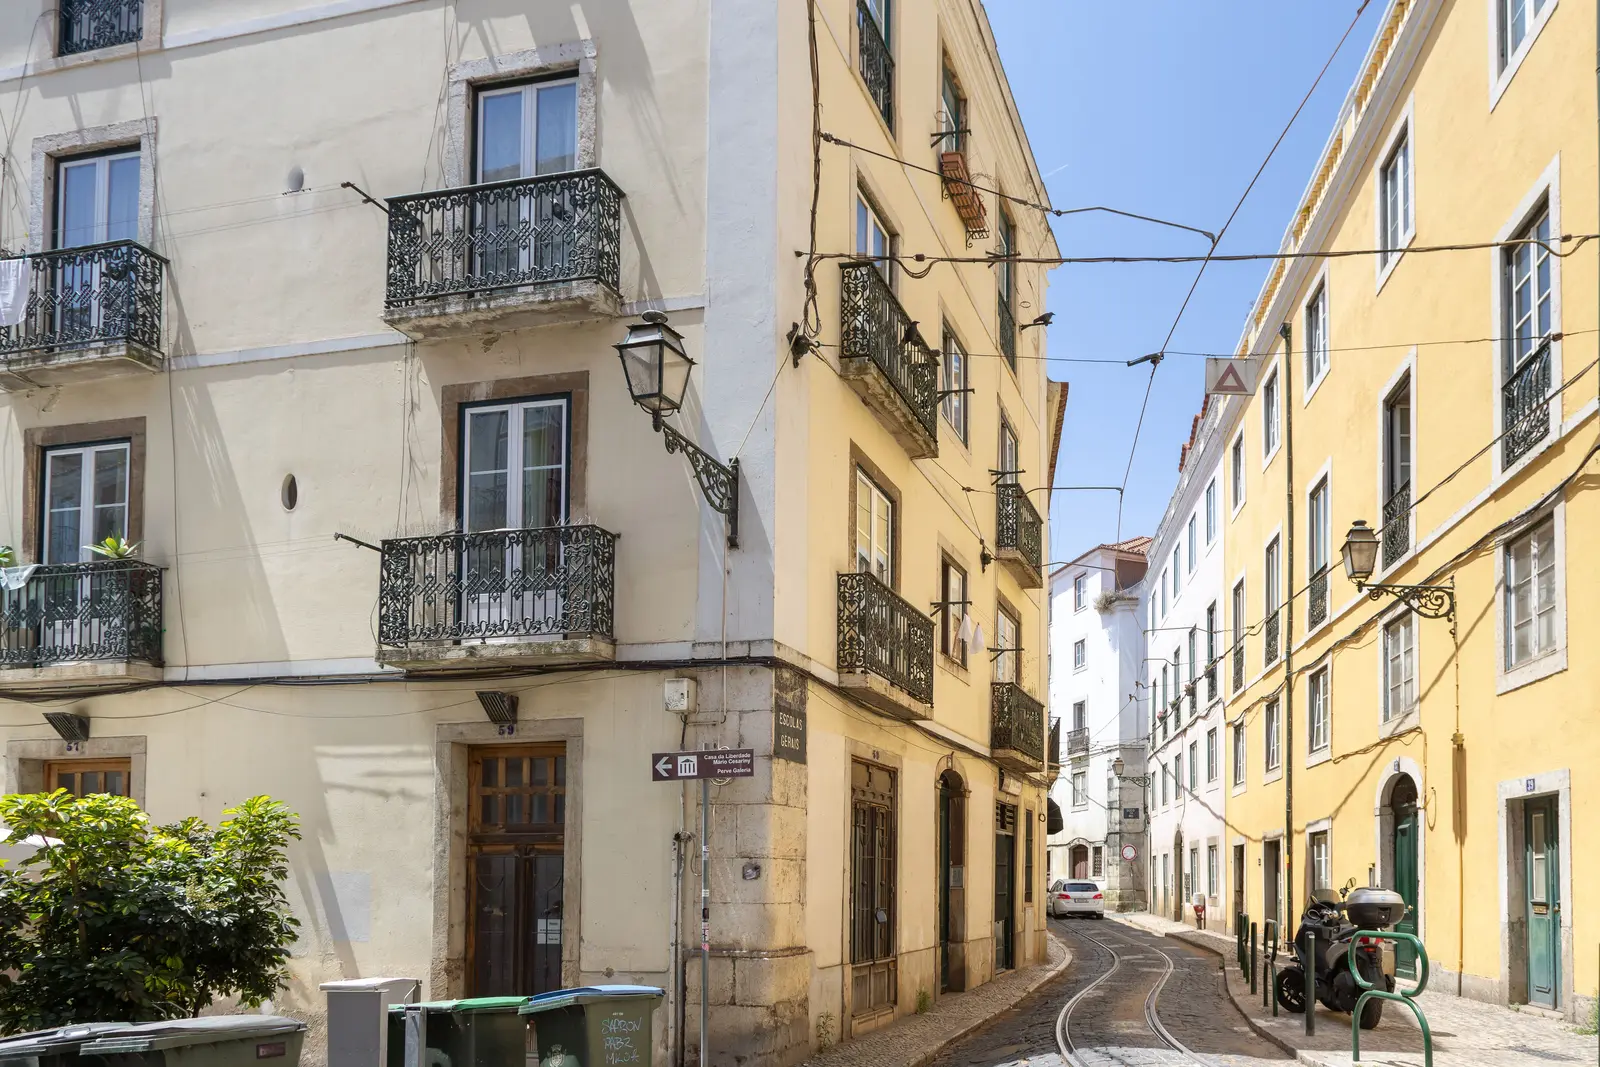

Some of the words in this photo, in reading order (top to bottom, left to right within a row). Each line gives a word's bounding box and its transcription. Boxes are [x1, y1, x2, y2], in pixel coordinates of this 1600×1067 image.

[779, 712, 803, 731] ESCOLAS
[498, 725, 514, 736] 59
[780, 734, 800, 750] GERAIS
